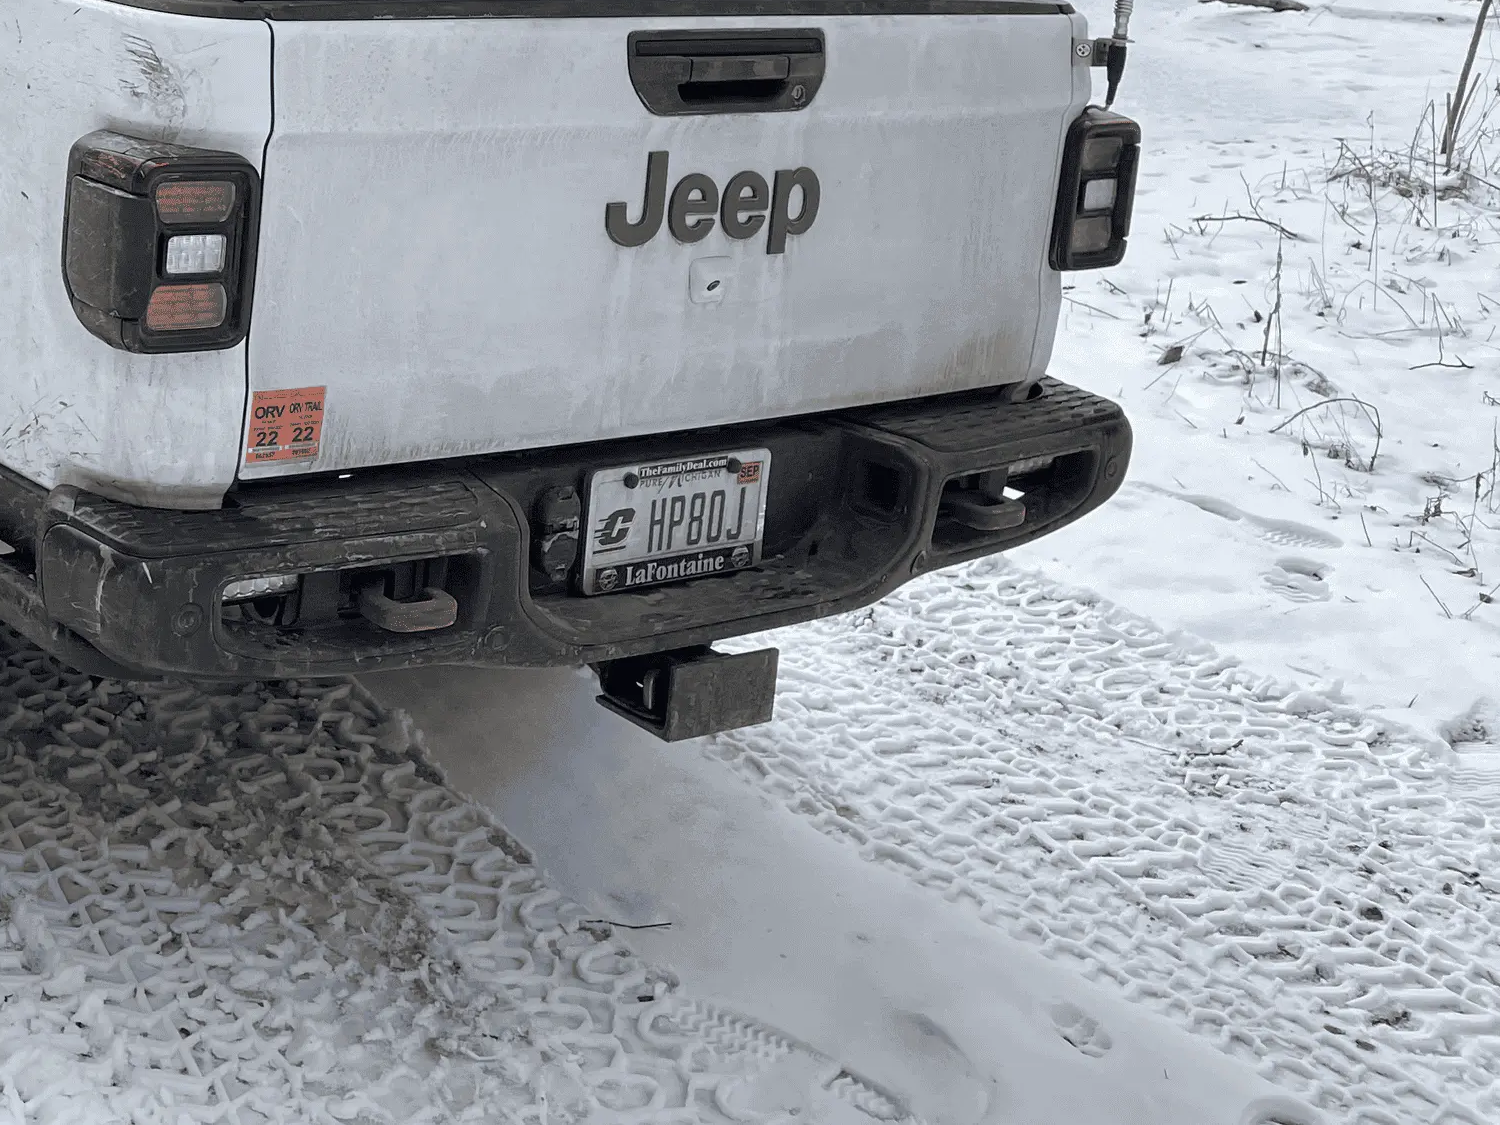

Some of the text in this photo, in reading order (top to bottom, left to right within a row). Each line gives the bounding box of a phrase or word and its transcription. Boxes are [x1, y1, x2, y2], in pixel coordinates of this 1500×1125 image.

[605, 150, 820, 254] Jeep
[254, 405, 285, 419] ORV
[305, 401, 322, 411] TRAIL
[256, 431, 279, 447] 22
[292, 426, 314, 442] 22
[639, 457, 728, 477] TheFamilyDeal.com
[740, 465, 760, 478] SEP
[640, 477, 663, 489] PURE
[625, 554, 725, 586] LaFontaine
